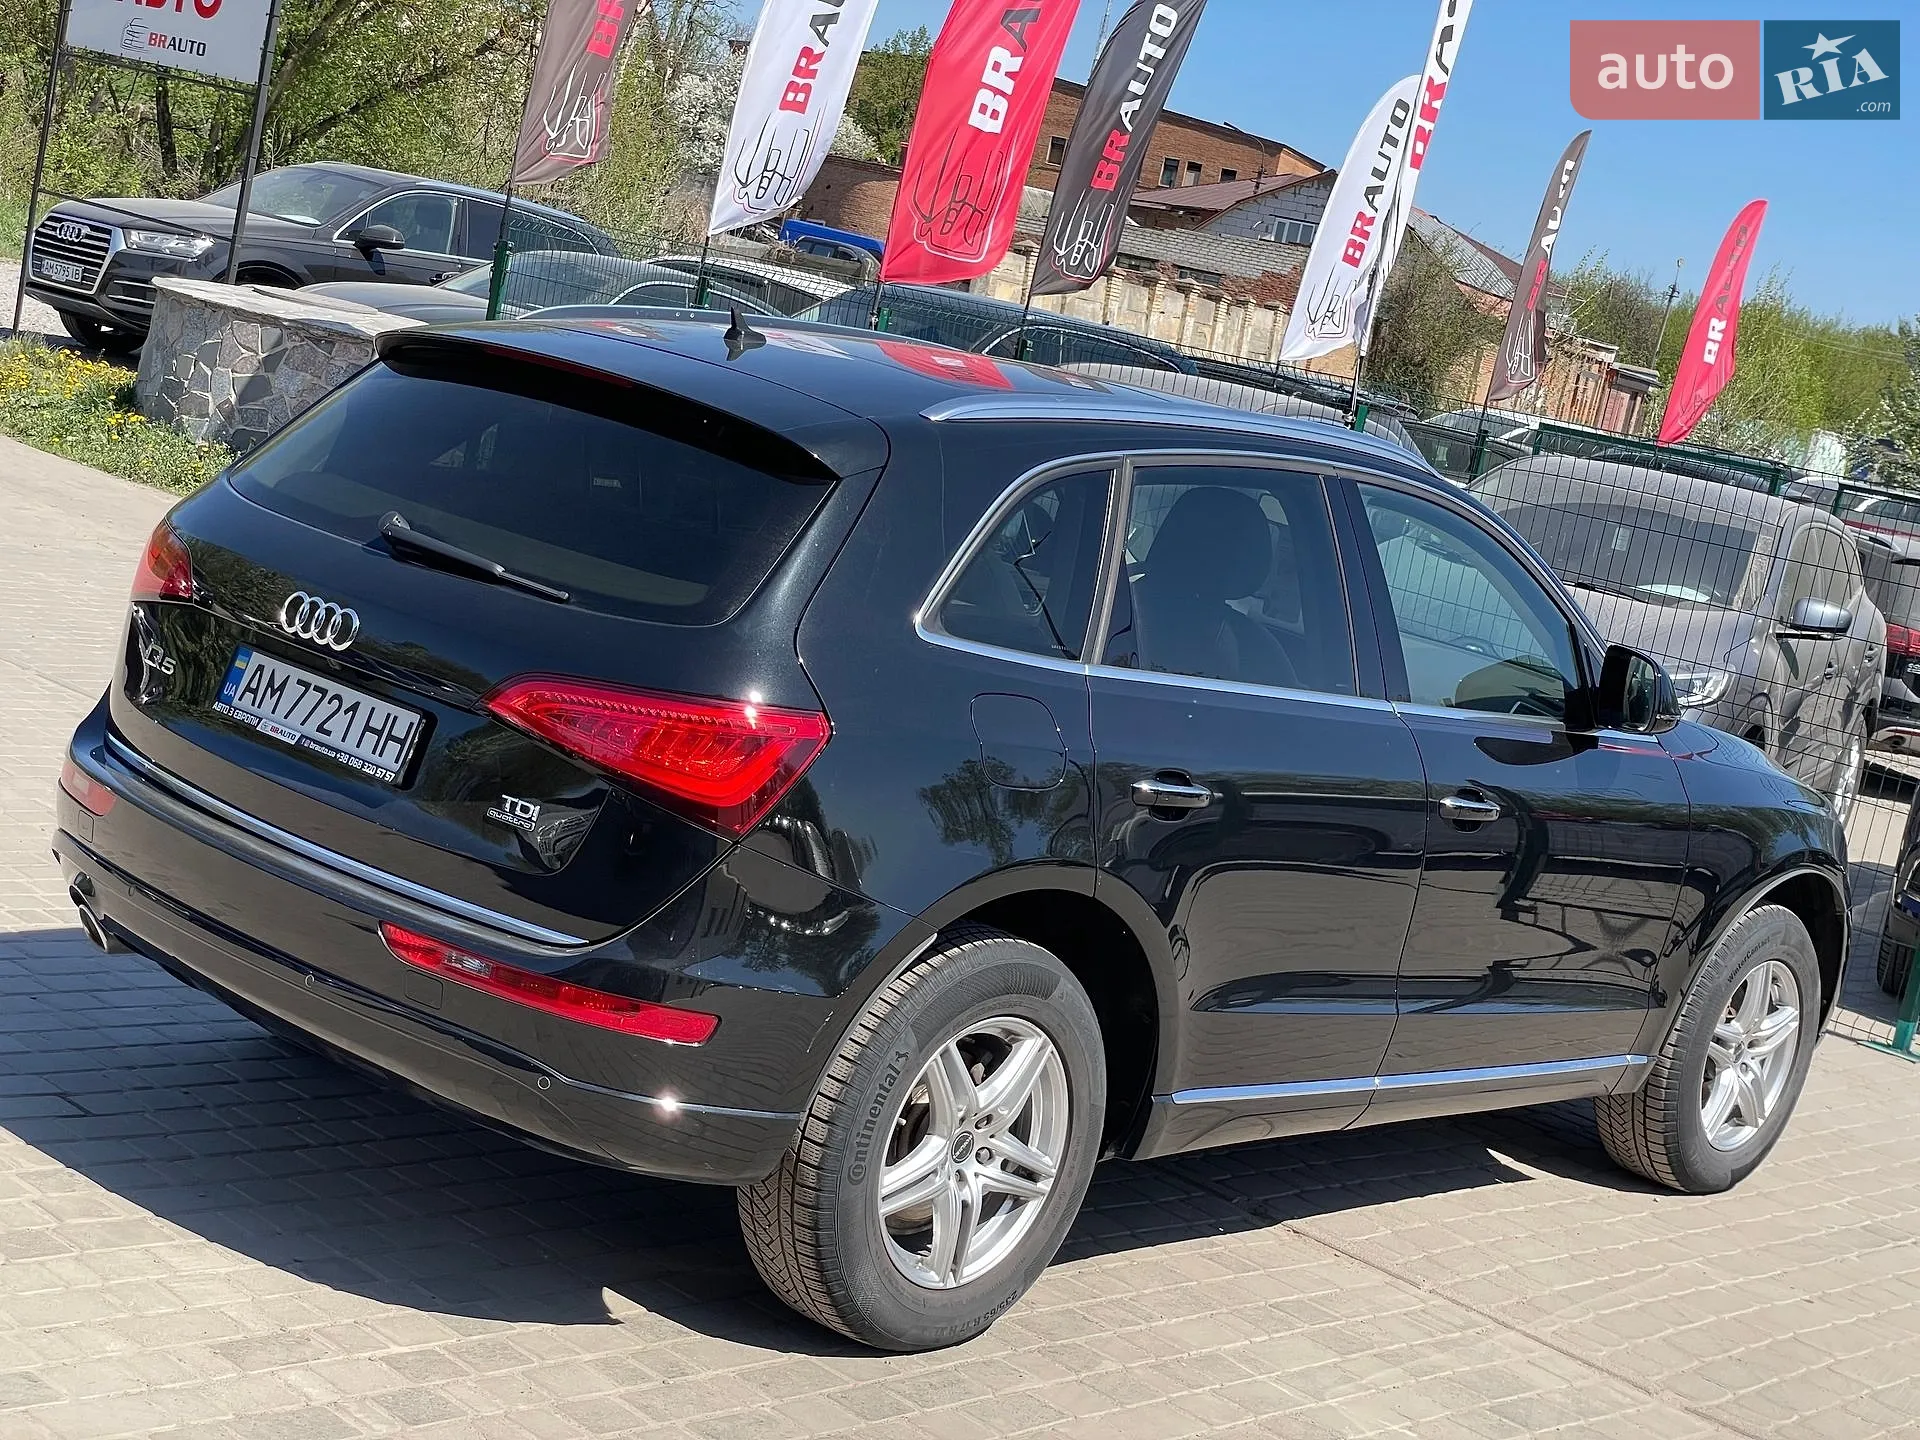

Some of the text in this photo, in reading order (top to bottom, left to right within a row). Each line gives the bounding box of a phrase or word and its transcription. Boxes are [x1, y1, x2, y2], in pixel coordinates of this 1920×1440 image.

[148, 32, 207, 57] BRAUTO
[779, 0, 846, 115] BRA
[967, 0, 1042, 135] BRA
[1090, 3, 1179, 192] BRAUTO
[1341, 98, 1411, 269] BRAUTO
[223, 682, 237, 698] UA
[237, 663, 415, 765] AM 7721 HH
[269, 725, 297, 741] BRAUTO
[489, 809, 532, 829] quattro
[501, 794, 541, 822] TDI
[847, 1062, 901, 1186] Continental
